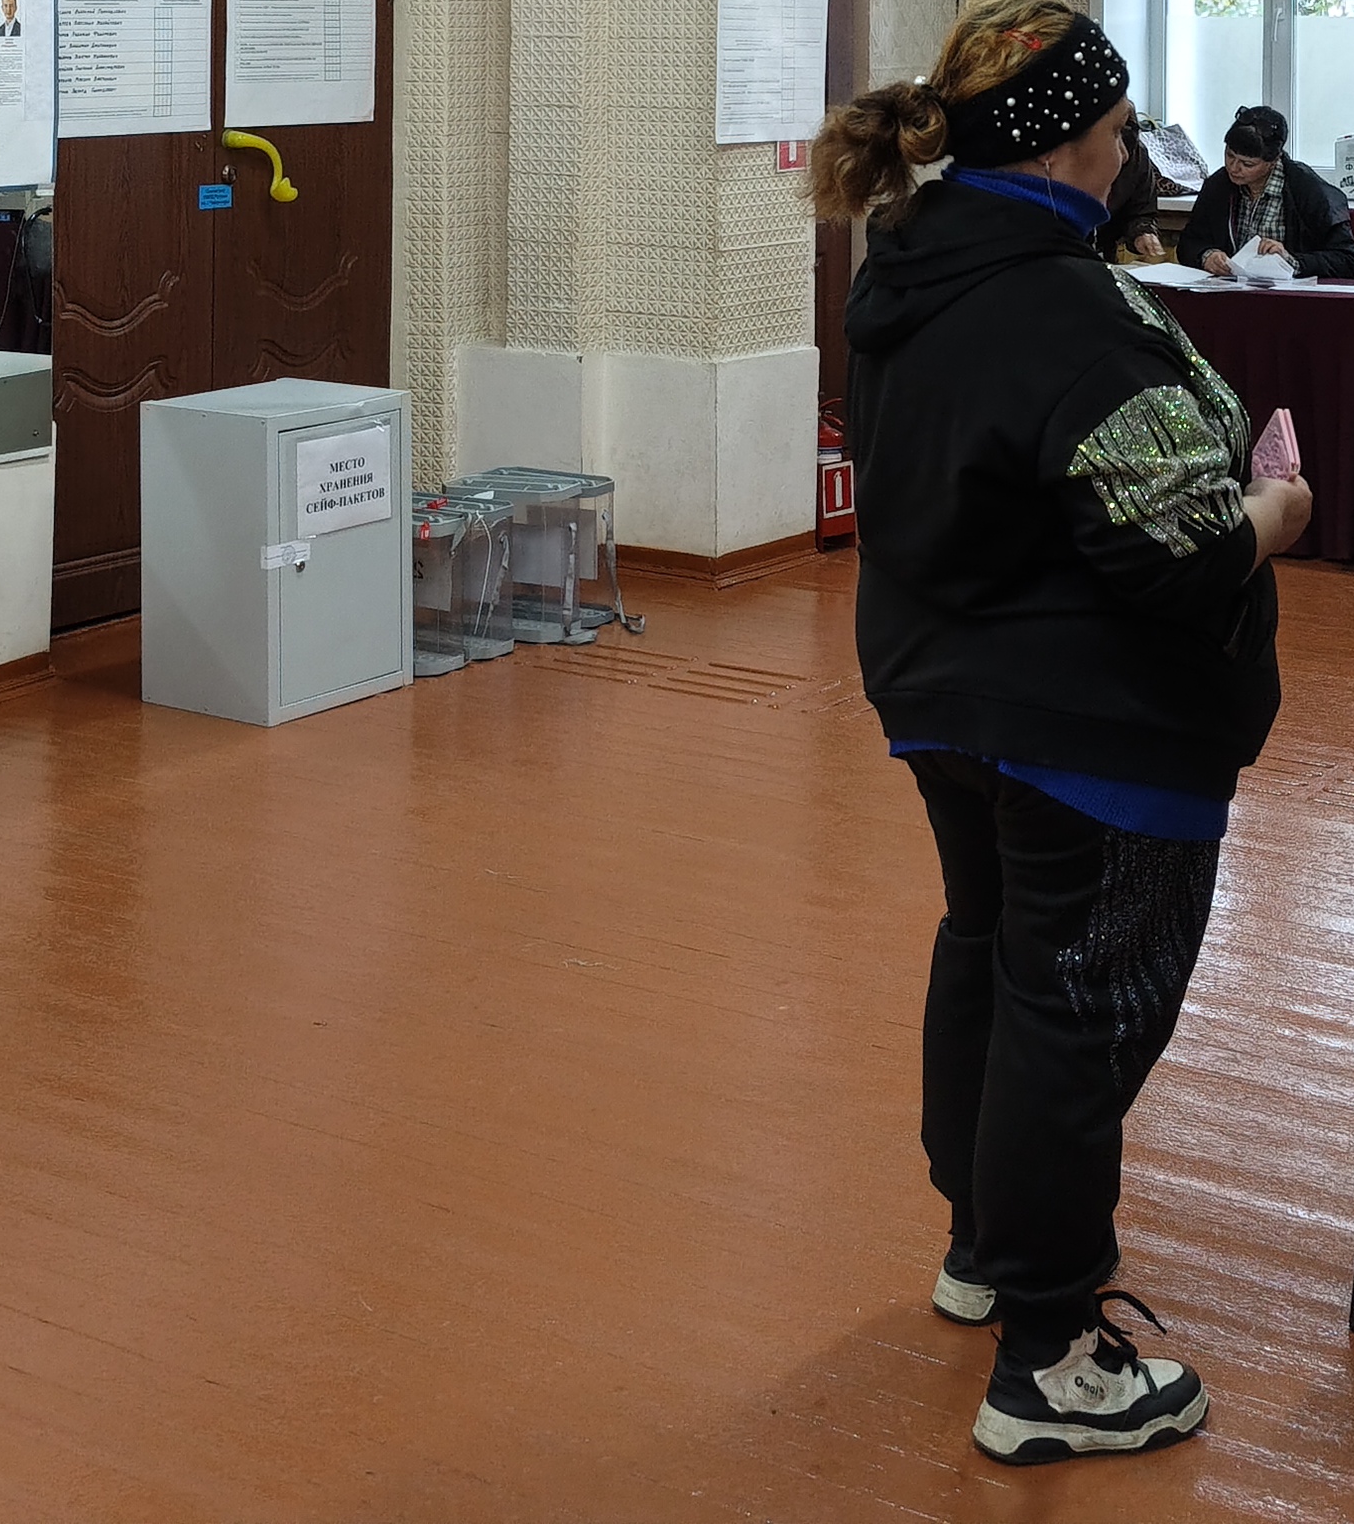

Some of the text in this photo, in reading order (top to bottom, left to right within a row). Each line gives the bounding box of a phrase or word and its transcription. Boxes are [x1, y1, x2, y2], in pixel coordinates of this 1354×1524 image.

[329, 456, 365, 474] МЕСТО
[319, 472, 373, 494] ХРАНЕНИЯ
[306, 487, 385, 514] СЕЙФ-ПАКЕТОВ
